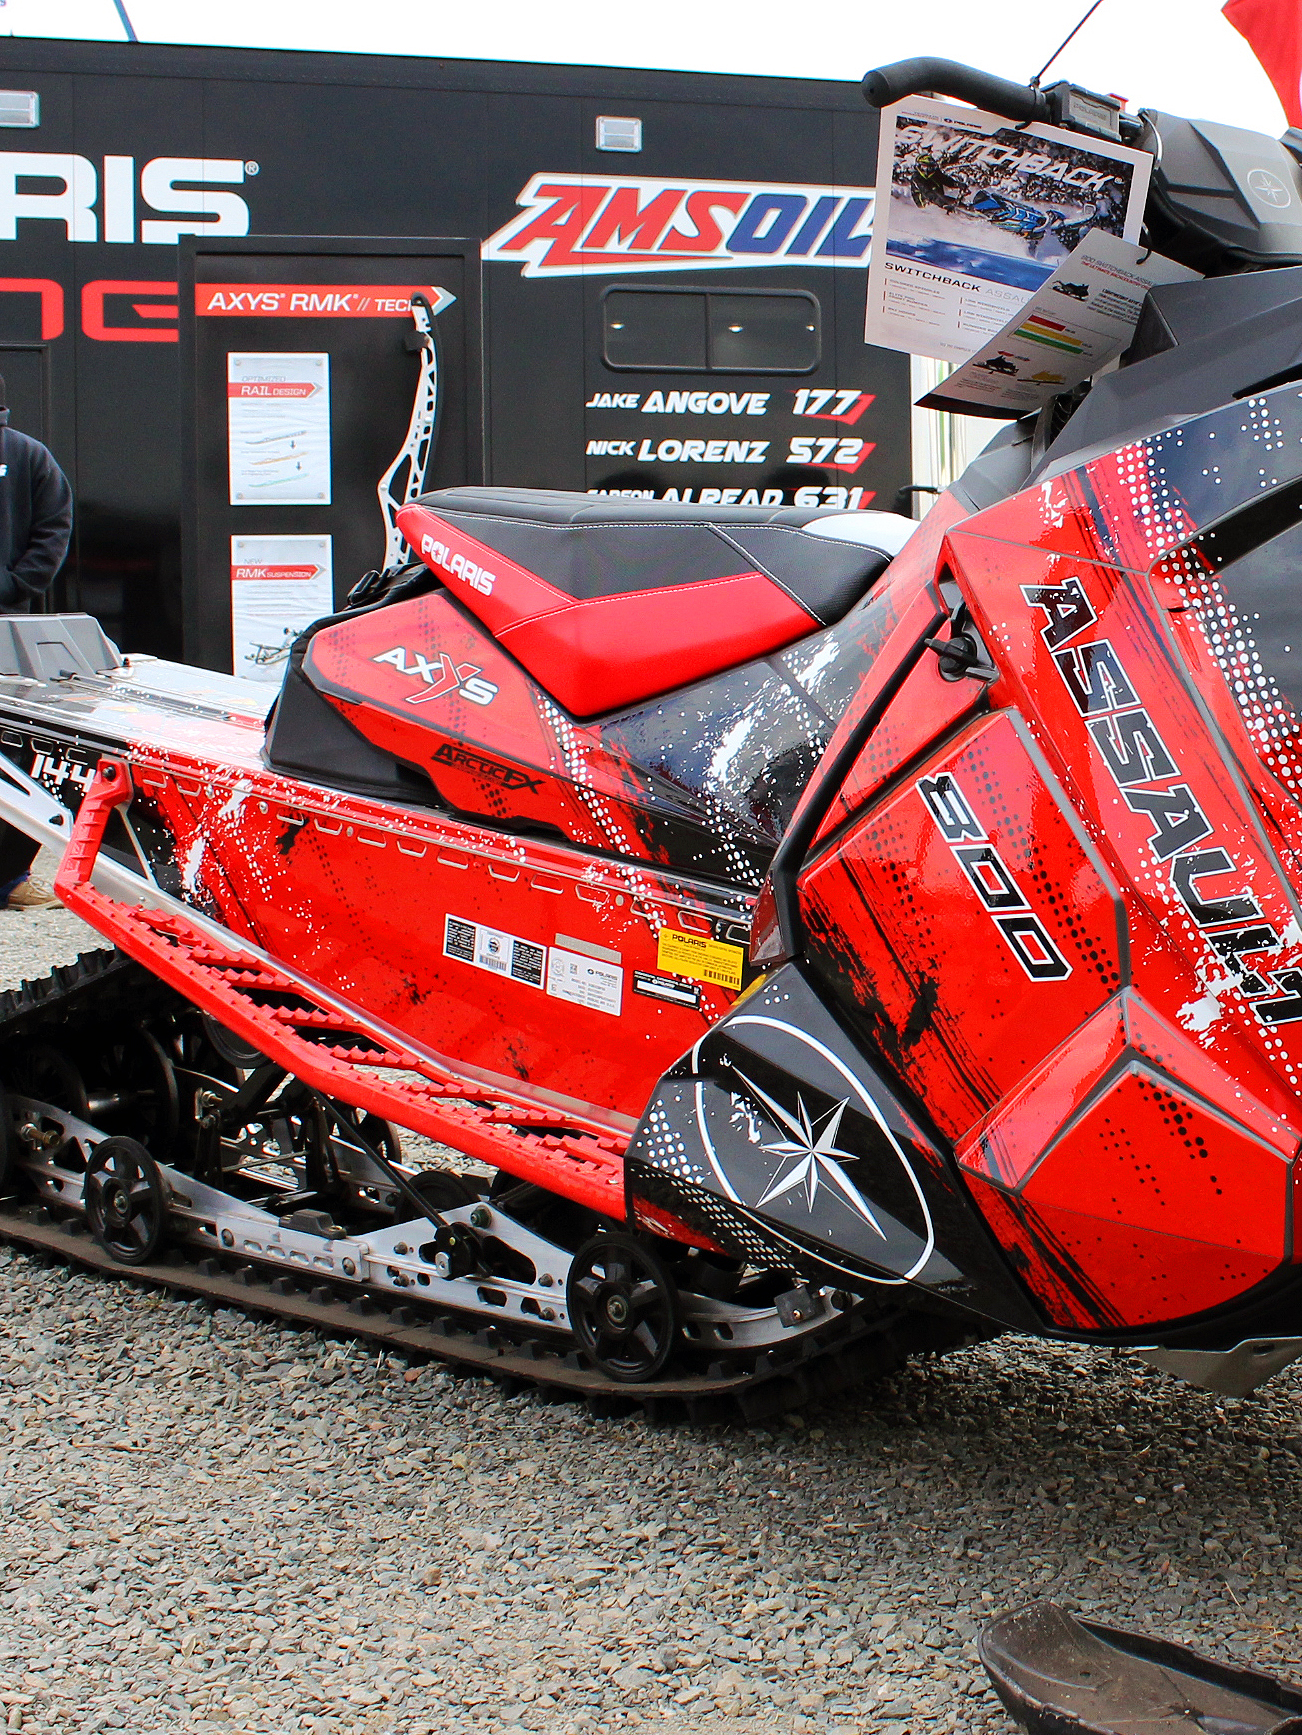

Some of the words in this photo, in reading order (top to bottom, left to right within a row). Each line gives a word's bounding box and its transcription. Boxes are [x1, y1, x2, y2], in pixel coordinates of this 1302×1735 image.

[896, 126, 1115, 192] SWITCHBACK
[498, 183, 874, 267] AMSOIL
[884, 261, 982, 293] SWITCHBACK
[207, 292, 278, 311] AXYS
[290, 293, 351, 312] RMK
[240, 385, 272, 396] RAIL
[272, 388, 307, 396] DESIGN
[586, 392, 641, 409] JAKE
[641, 390, 771, 416] ANGOVE
[792, 388, 863, 416] 177
[585, 440, 637, 457] NICK
[637, 438, 771, 464] LORENZ
[786, 436, 865, 464] 572
[793, 486, 864, 510] 631
[236, 567, 267, 579] RMK
[421, 533, 497, 597] POLARIS
[370, 645, 498, 706] AXYS
[30, 753, 97, 793] 144
[916, 772, 1074, 982] 800
[671, 933, 707, 949] POLARIS
